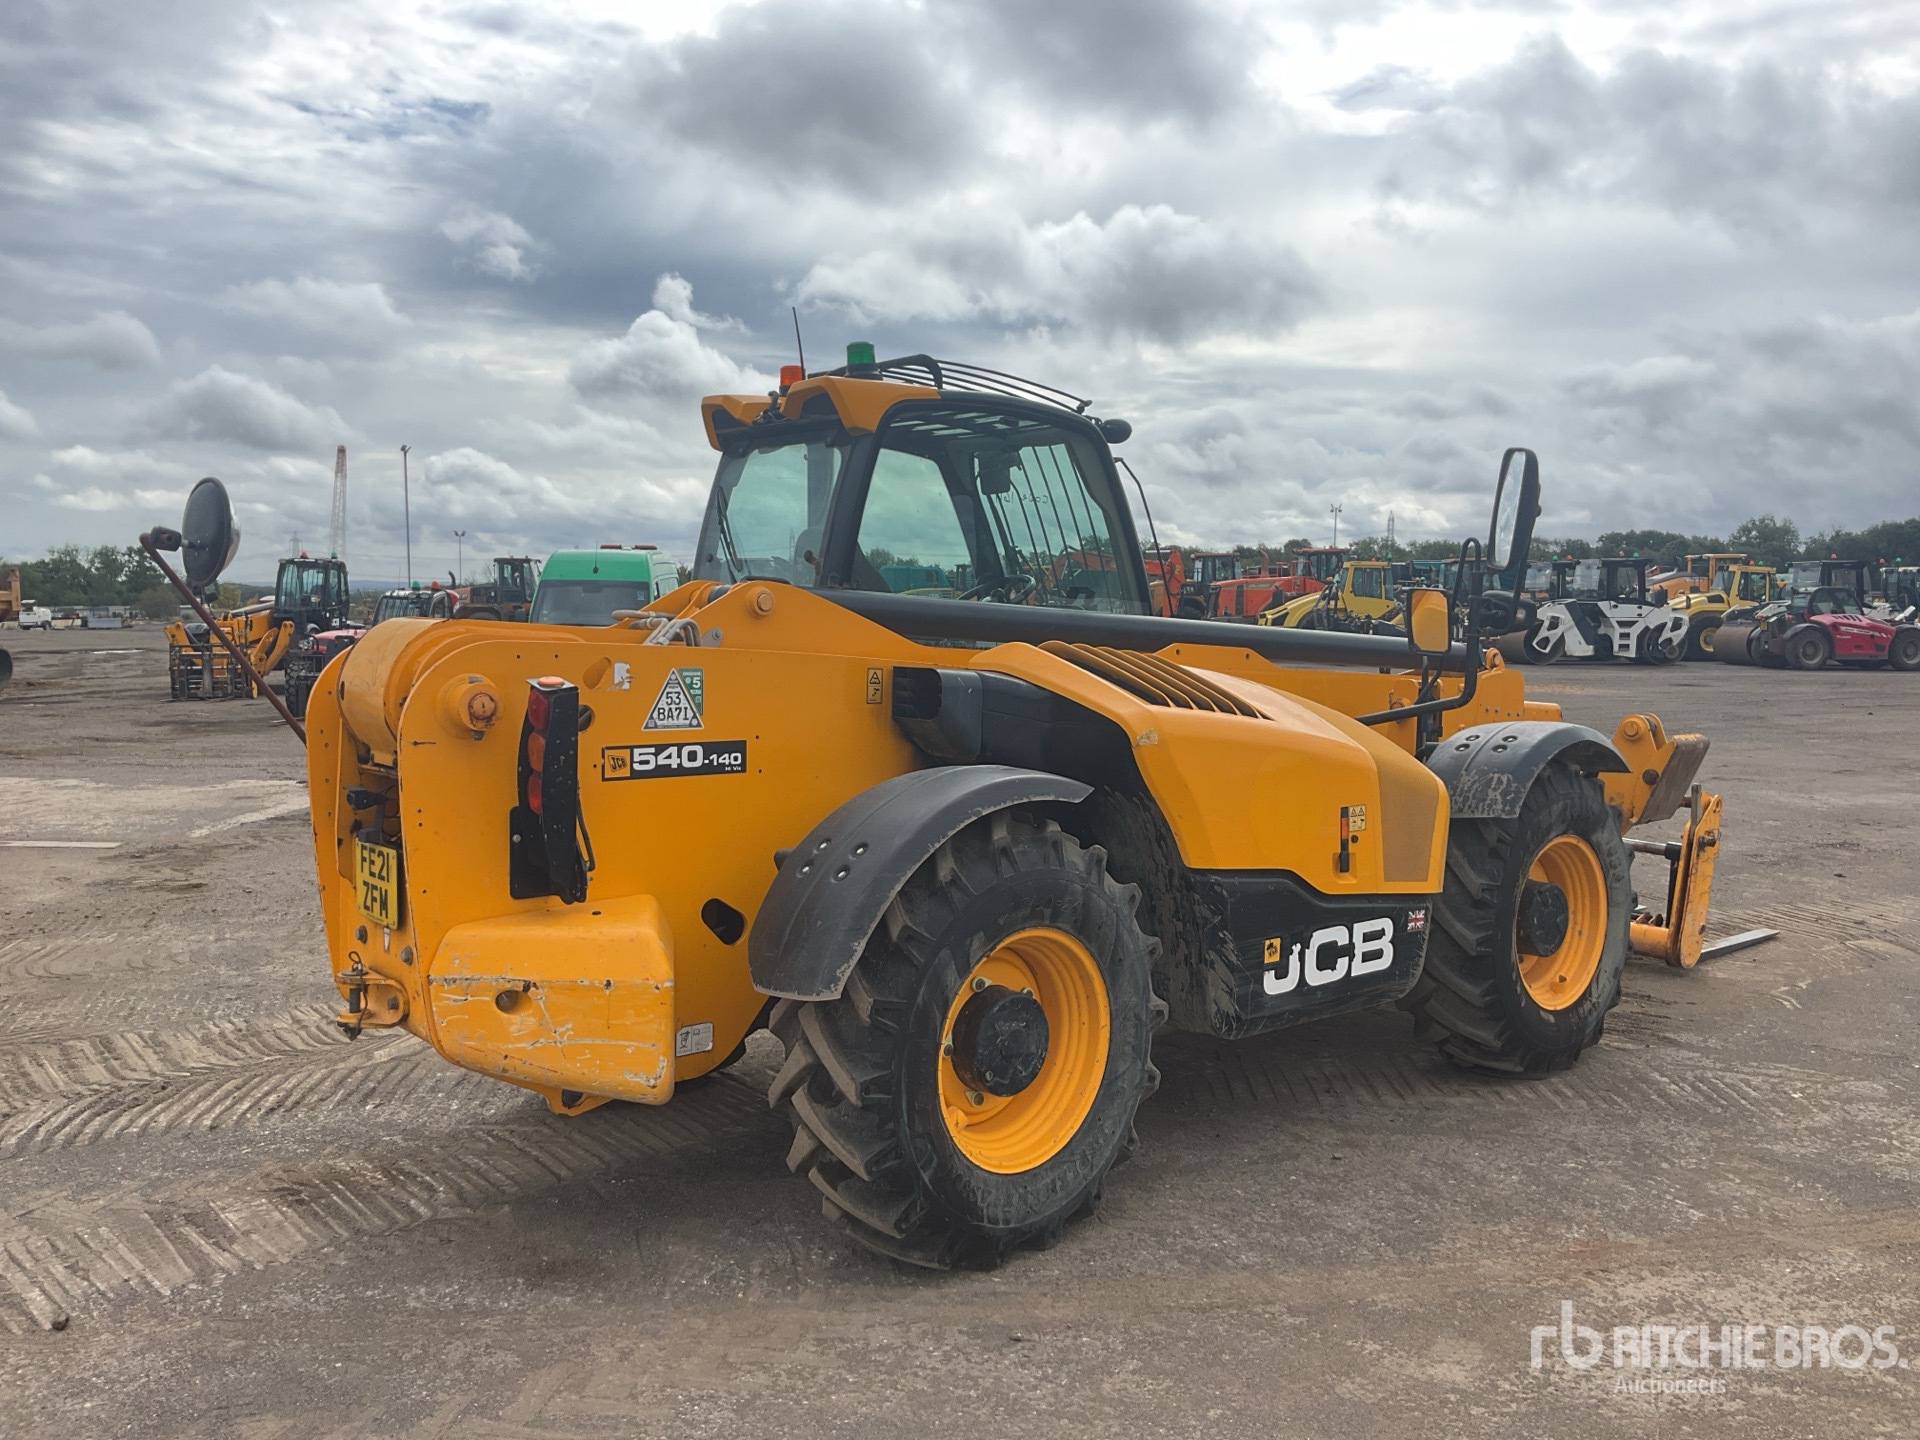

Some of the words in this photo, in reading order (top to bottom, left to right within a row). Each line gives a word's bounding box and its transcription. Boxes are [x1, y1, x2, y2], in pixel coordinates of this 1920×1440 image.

[665, 691, 681, 706] 53
[692, 676, 701, 688] 5
[610, 756, 627, 770] JCB
[633, 745, 742, 771] 540-140
[360, 843, 390, 884] FE21
[362, 880, 388, 920] ZFM
[1263, 917, 1394, 995] JCB
